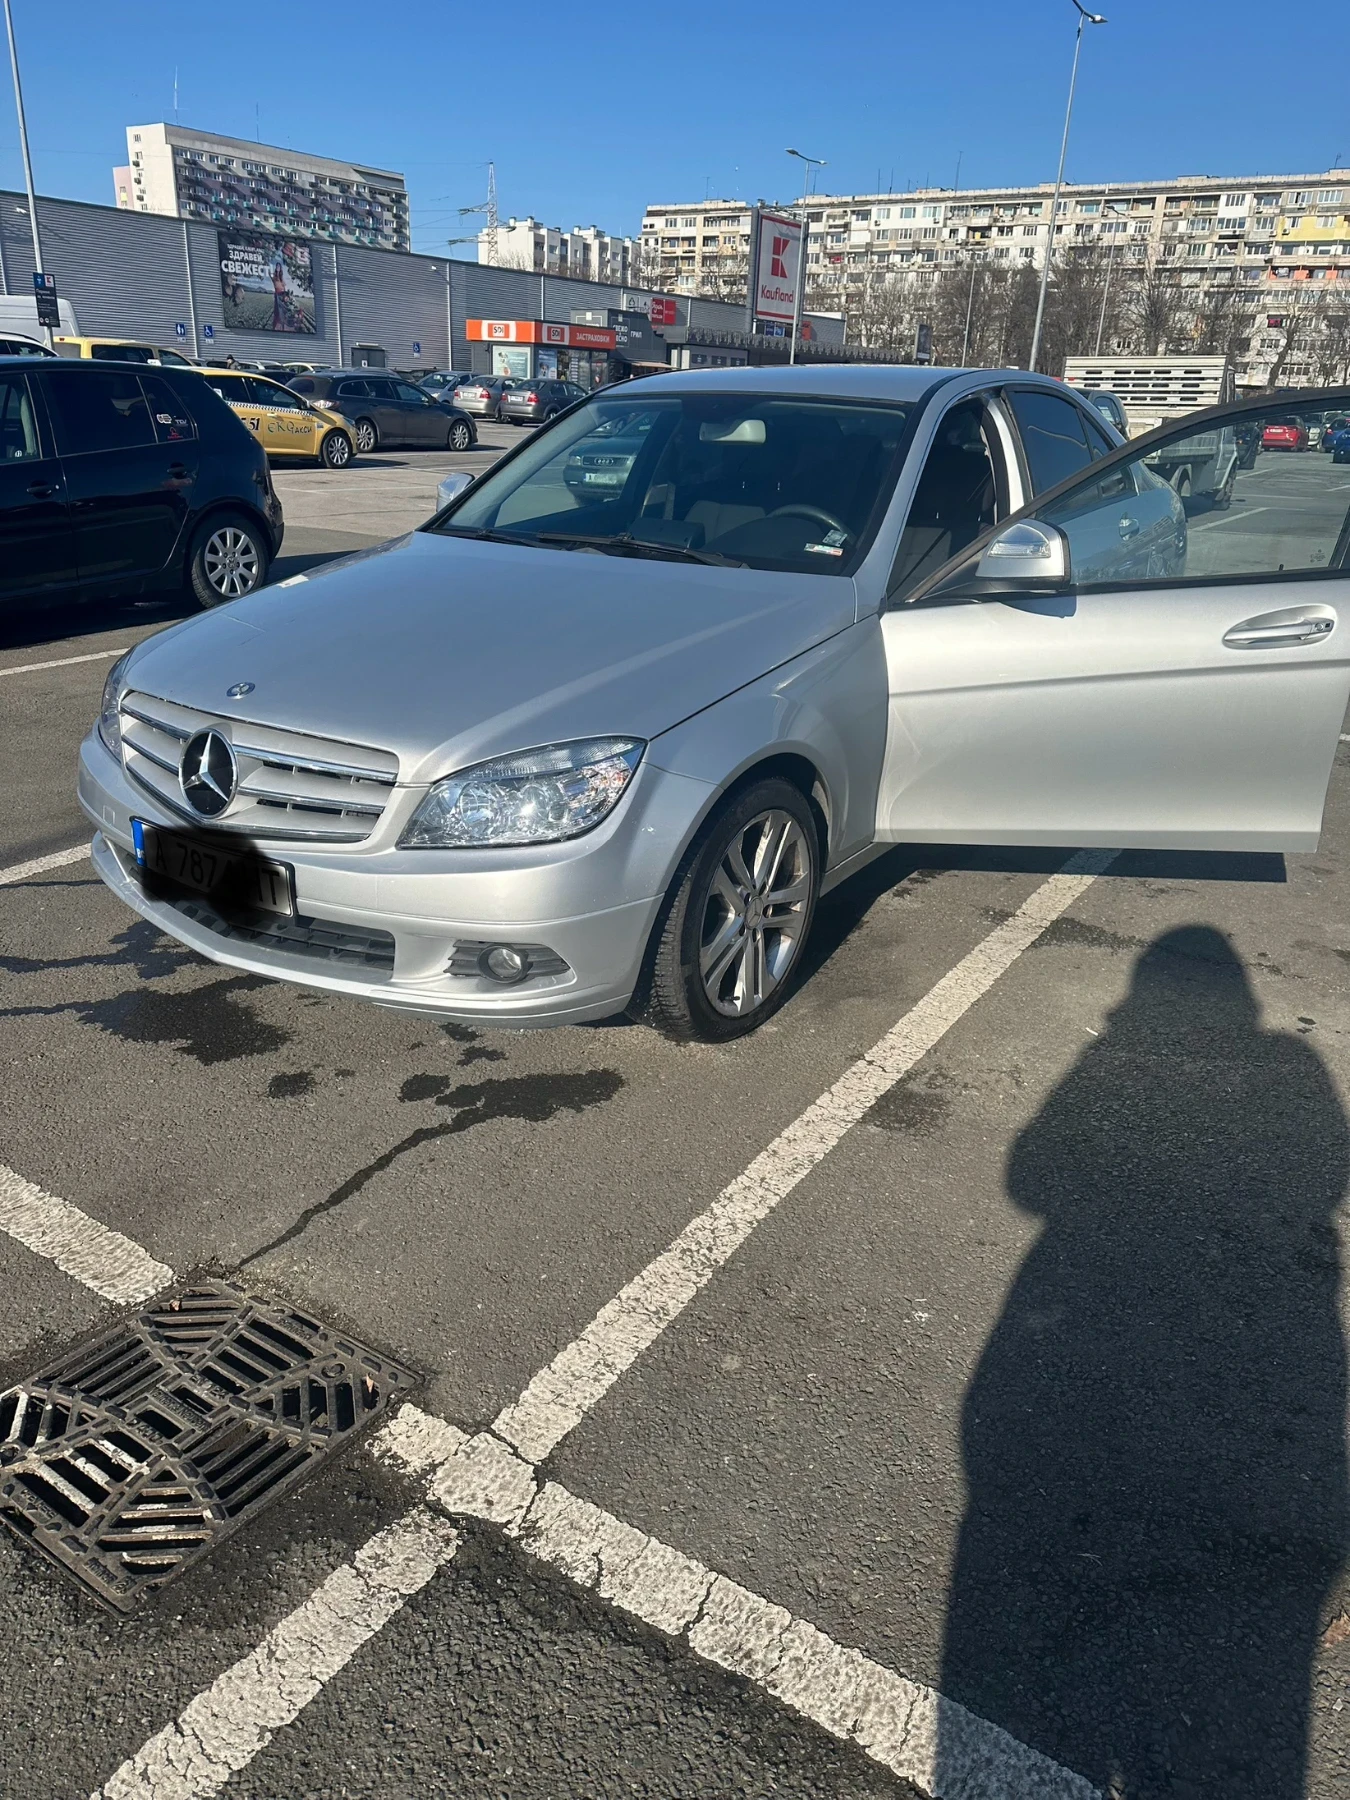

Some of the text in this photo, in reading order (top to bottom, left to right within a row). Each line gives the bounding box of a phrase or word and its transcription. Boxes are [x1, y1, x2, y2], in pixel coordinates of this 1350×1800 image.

[228, 250, 265, 264] ЗДРАВЕЙ,
[221, 260, 275, 278] СВЕЖЕСТ!
[761, 284, 794, 303] Kaufland
[493, 325, 504, 334] SDI
[551, 329, 560, 337] SDI
[630, 330, 643, 338] ГРИЛ
[576, 332, 610, 343] ЗАСТРАХОВКИ
